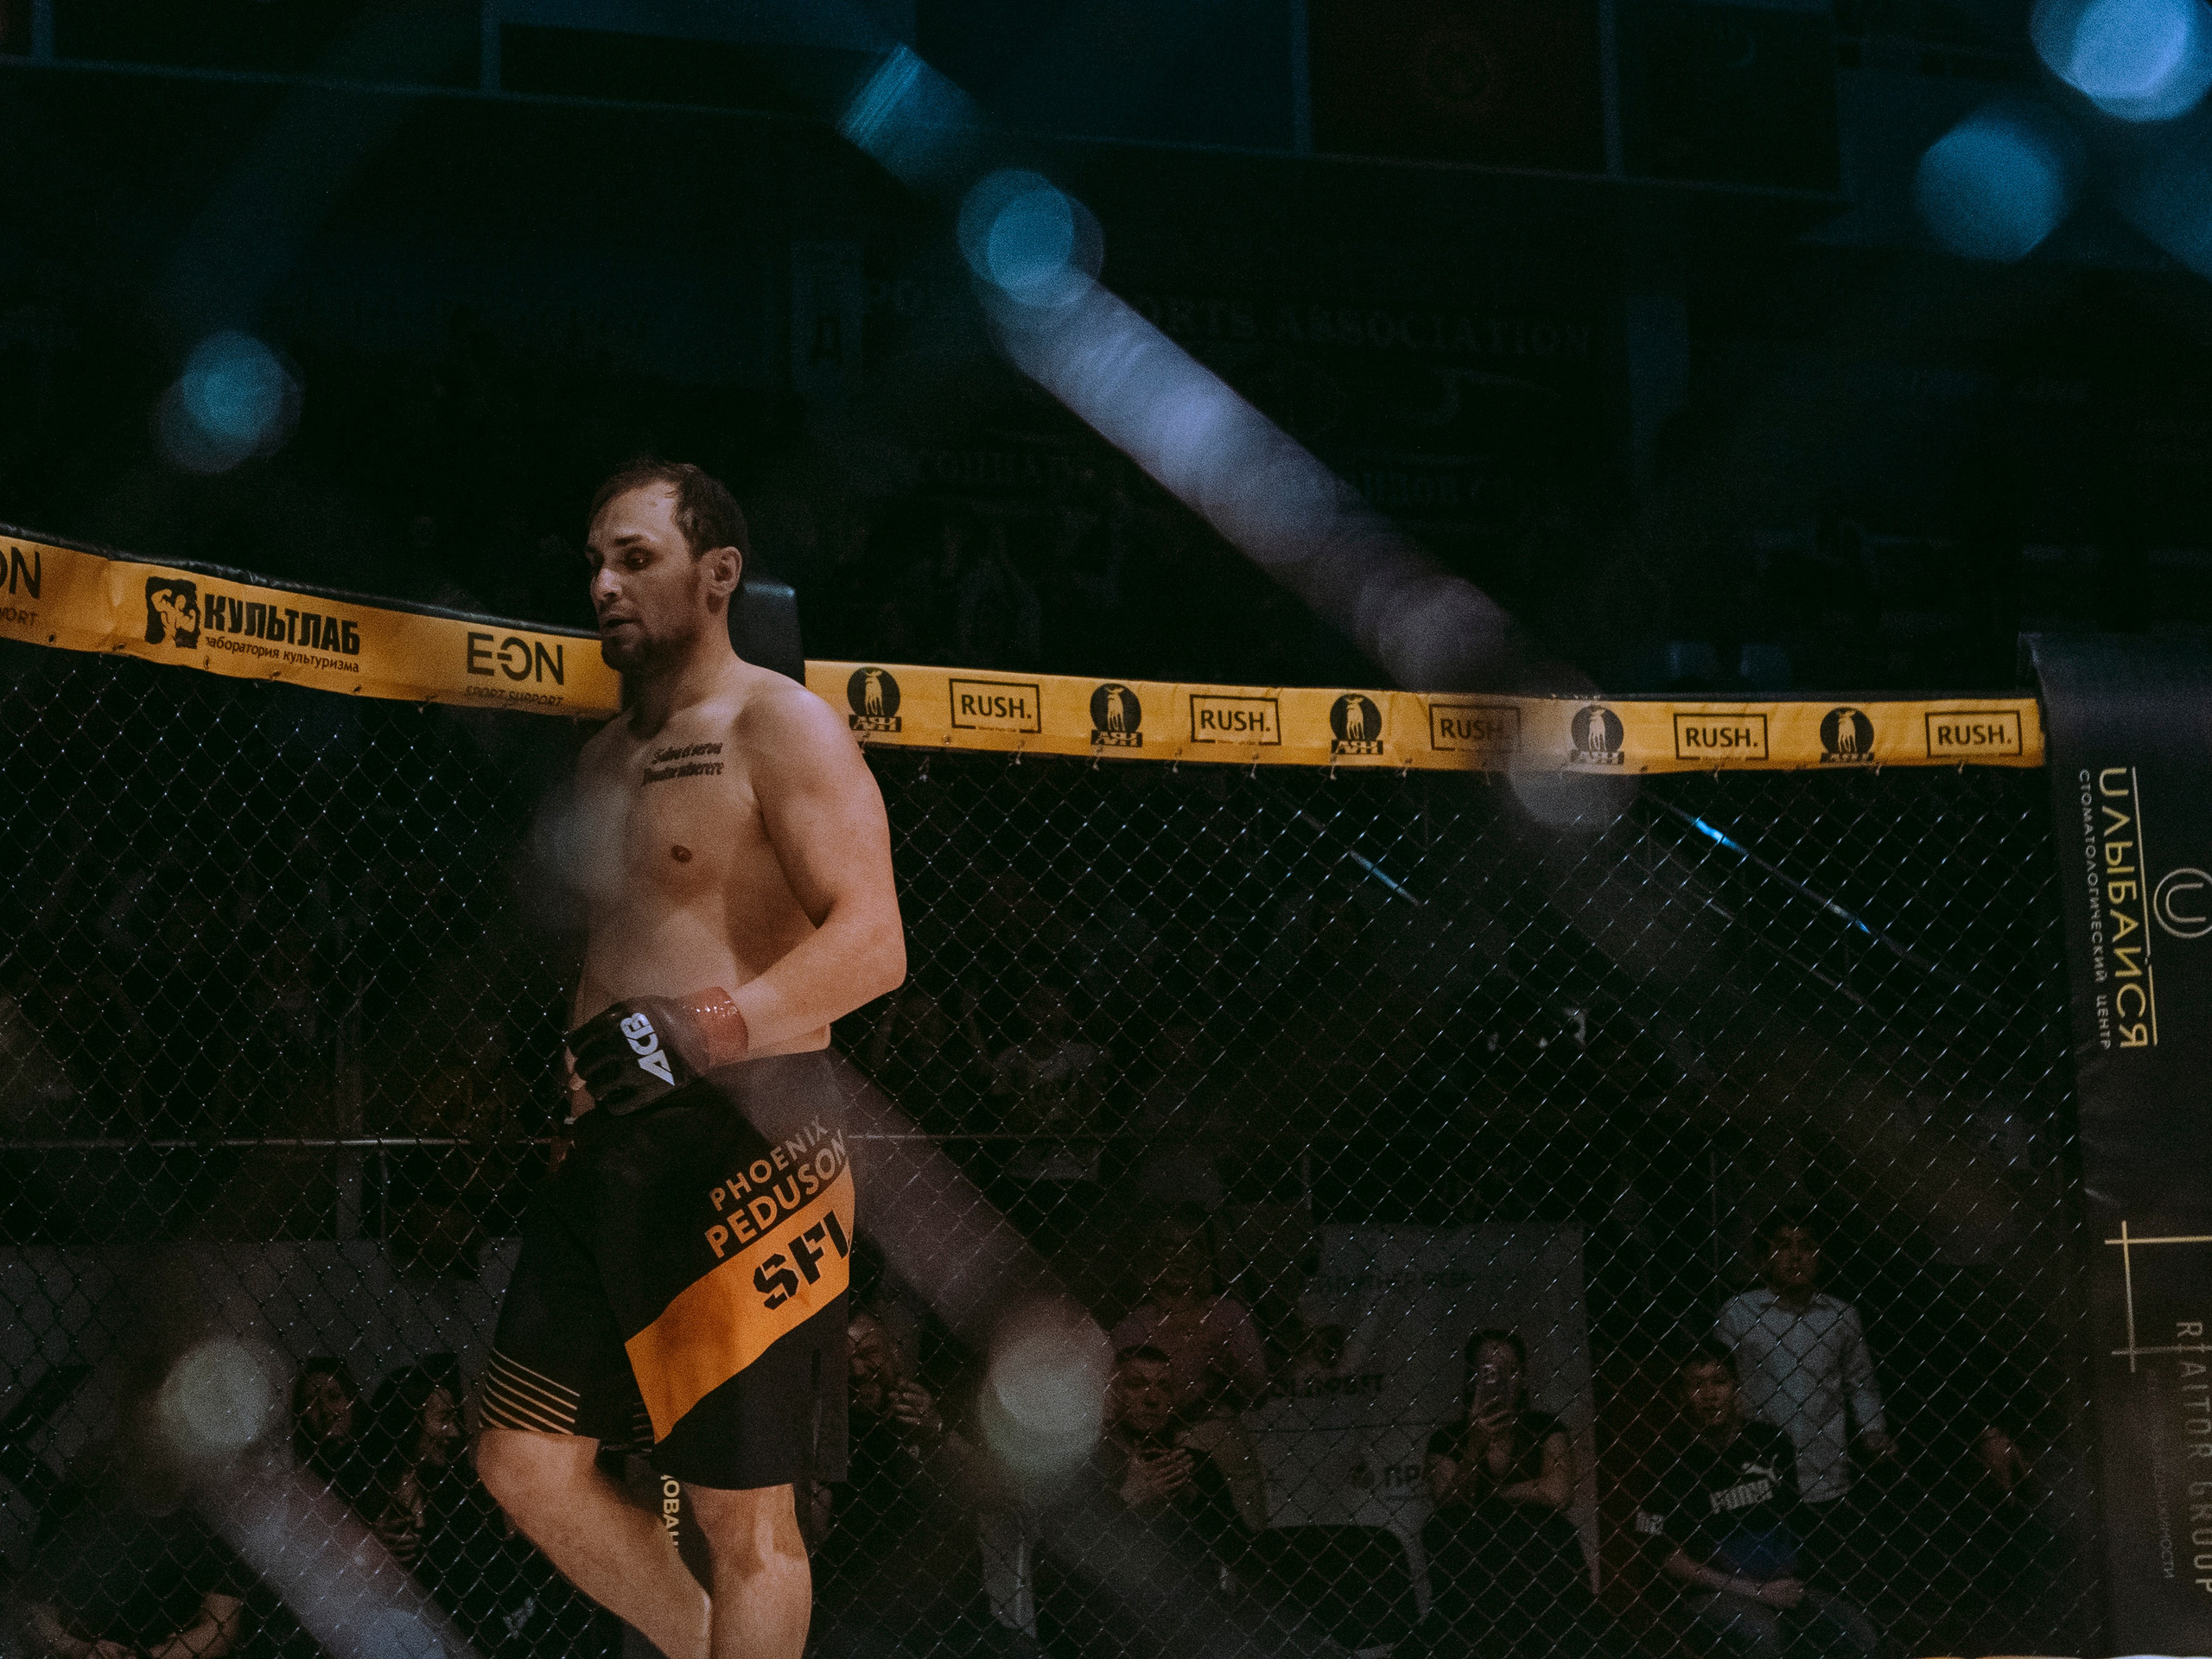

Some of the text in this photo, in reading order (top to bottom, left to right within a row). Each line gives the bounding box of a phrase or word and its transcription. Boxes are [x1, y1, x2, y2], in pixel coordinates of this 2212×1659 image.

[204, 594, 360, 656] КУЛЬТЛАБ
[283, 650, 359, 673] культуризма
[464, 685, 564, 707] SPORT SUPPORT
[961, 694, 1032, 719] RUSH.
[1200, 709, 1271, 732] RUSH.
[1686, 728, 1758, 747] RUSH.
[1937, 724, 2012, 746] RUSH.
[2078, 767, 2111, 1051] СТОМАТОЛОГИЧЕСКИЙ ЦЕНТР
[620, 1012, 676, 1087] ACB
[708, 1115, 828, 1212] PHOENIX
[704, 1128, 847, 1259] PEDUSON
